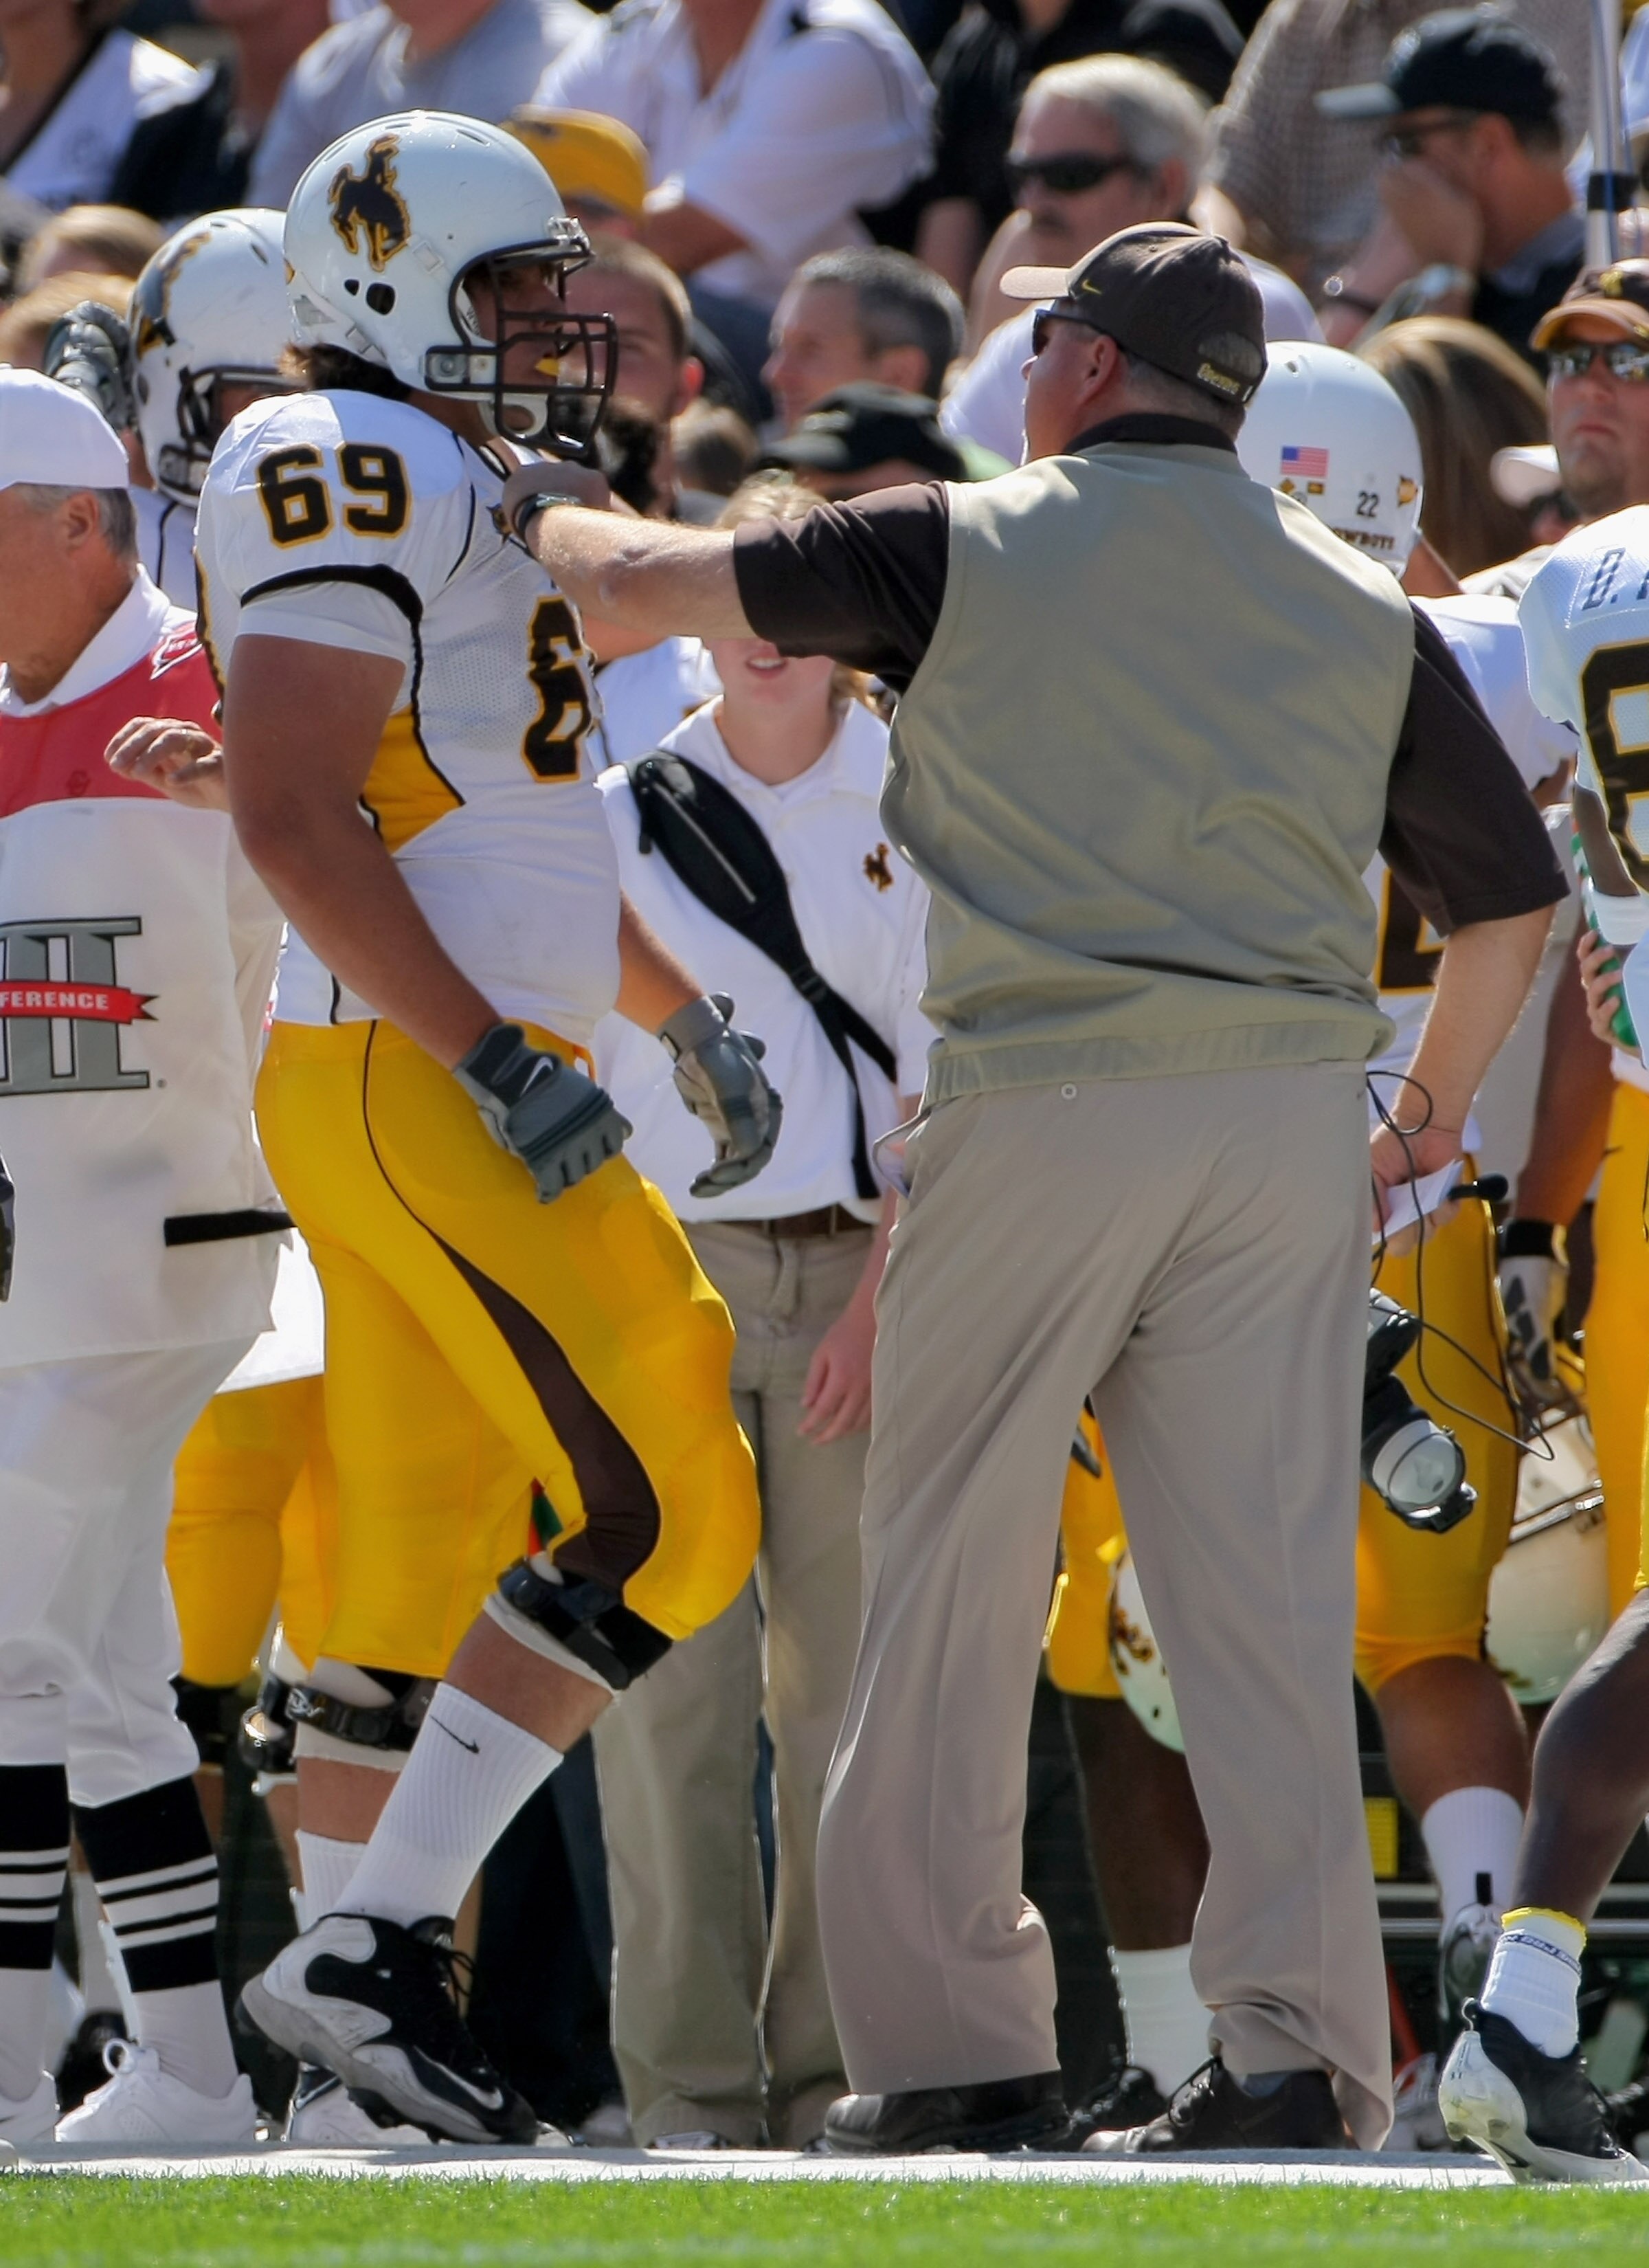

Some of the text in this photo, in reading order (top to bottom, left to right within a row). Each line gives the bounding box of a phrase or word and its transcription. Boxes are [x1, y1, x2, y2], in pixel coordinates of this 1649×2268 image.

[256, 442, 414, 550] 69
[1356, 490, 1380, 518] 22
[521, 594, 596, 784] 6
